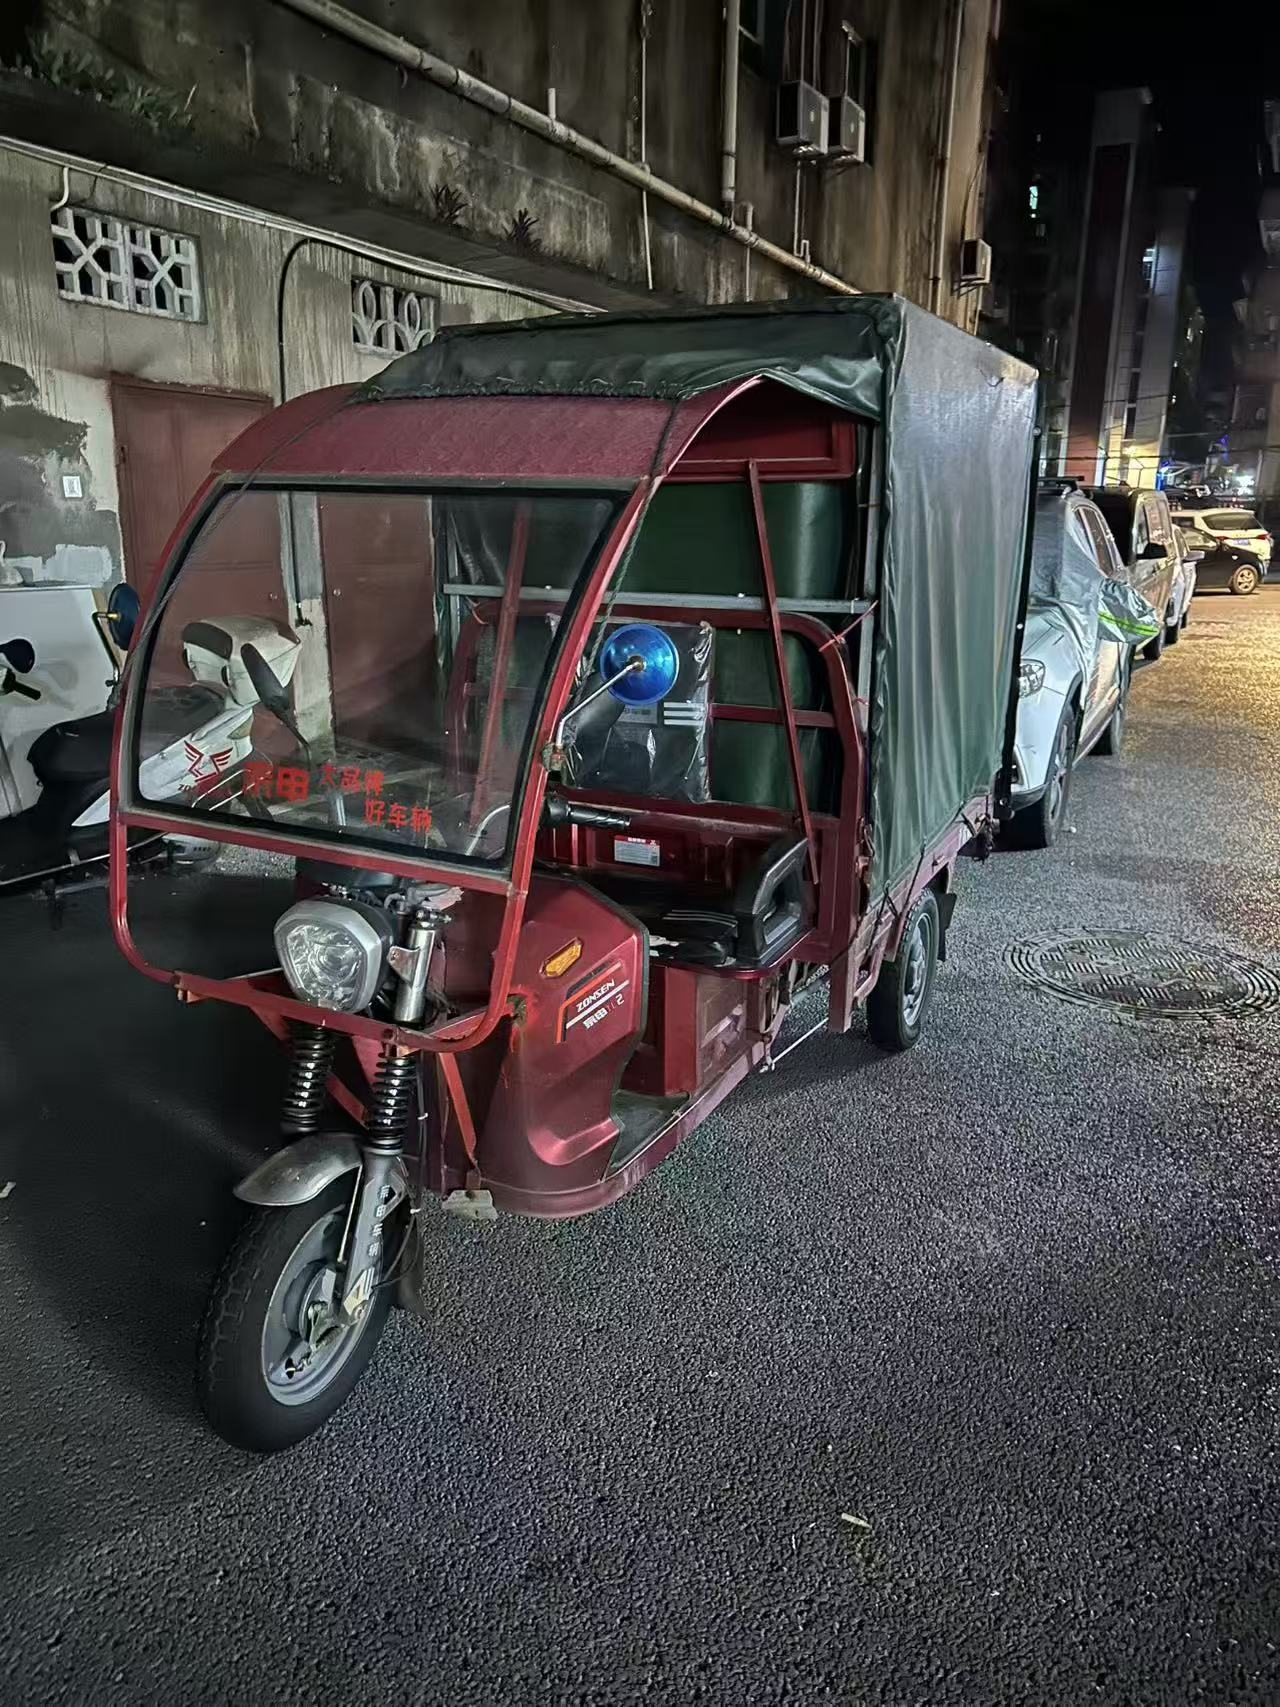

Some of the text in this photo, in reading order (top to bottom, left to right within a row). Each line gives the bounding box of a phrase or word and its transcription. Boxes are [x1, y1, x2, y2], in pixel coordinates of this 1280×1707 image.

[320, 763, 385, 796] 大品牌
[365, 800, 432, 833] 好车辆
[576, 979, 615, 1012] ZONSEN
